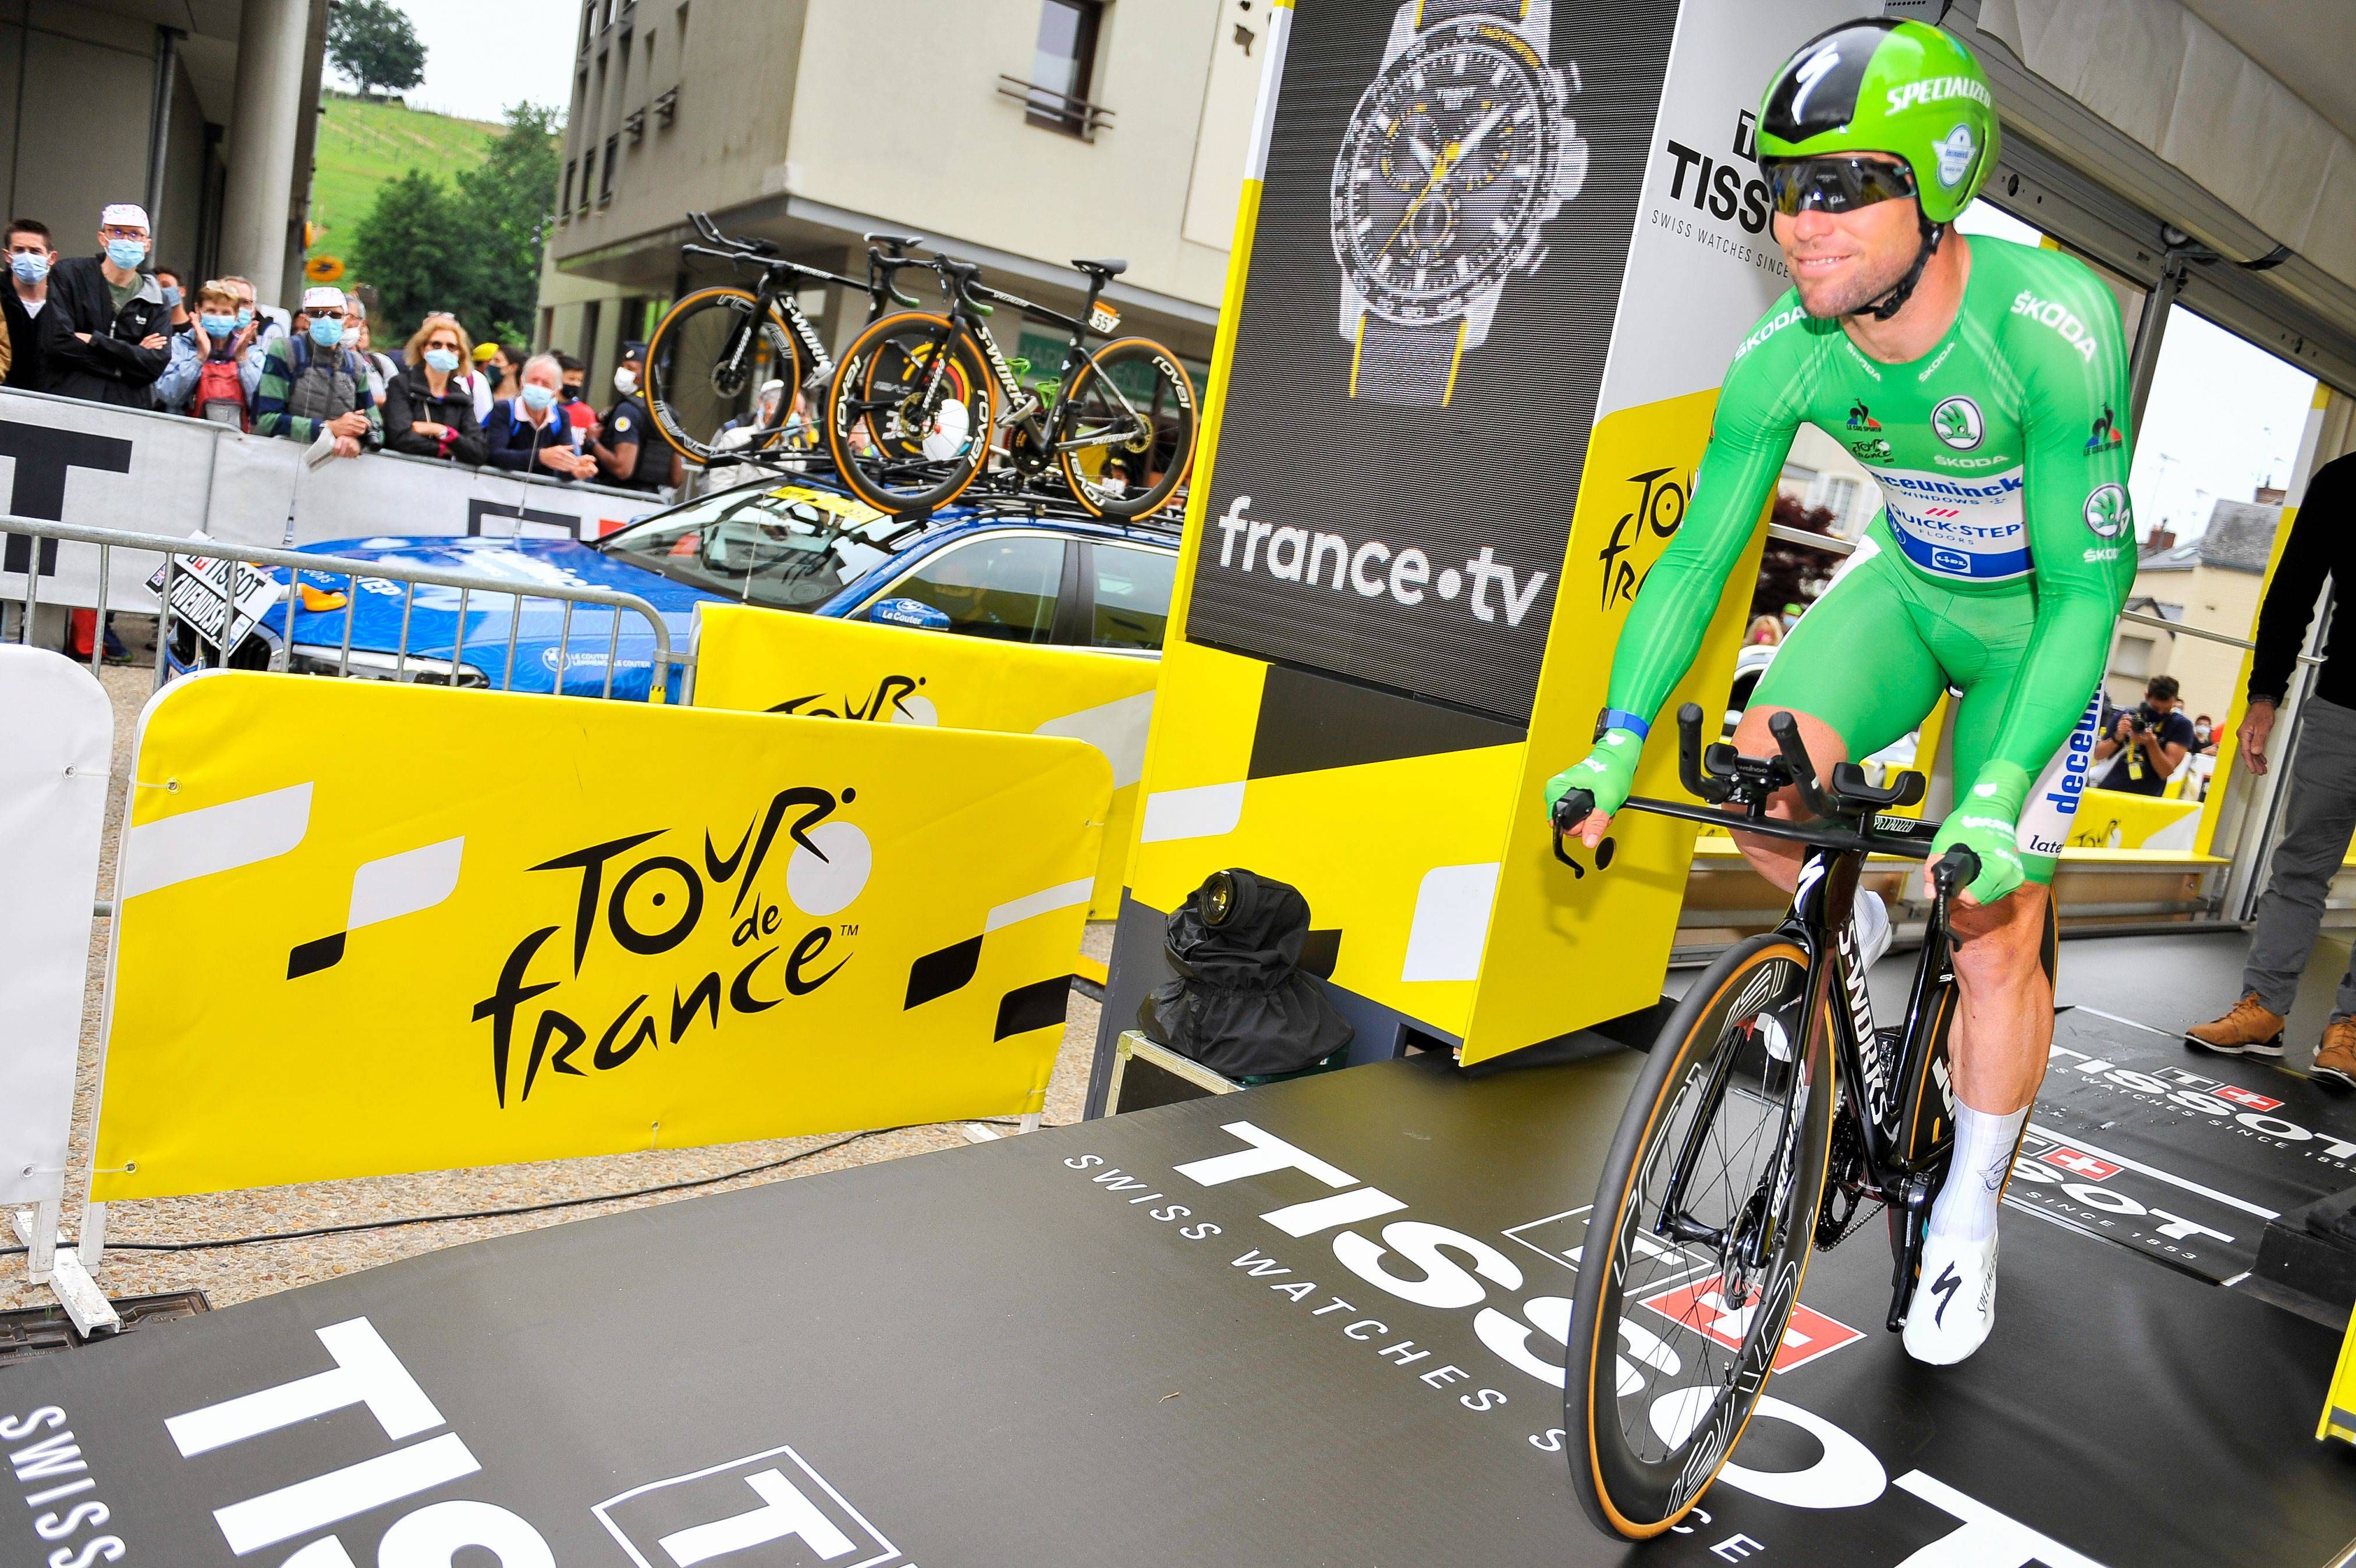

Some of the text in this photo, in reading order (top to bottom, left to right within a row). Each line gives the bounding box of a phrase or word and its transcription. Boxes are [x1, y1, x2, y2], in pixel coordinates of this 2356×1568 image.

[1651, 209, 1789, 278] SWISS WATCHES SINCE
[779, 296, 831, 363] S-WORK
[1095, 314, 1107, 330] 55
[2010, 289, 2098, 363] ŠKODA
[837, 354, 861, 437] roval
[974, 326, 1027, 409] S-WORK
[1151, 356, 1191, 408] roval
[963, 389, 989, 467] roval
[1069, 450, 1106, 506] roval
[1900, 489, 1980, 505] WINDOWS
[1919, 528, 1974, 545] FLOORS
[882, 609, 893, 620] Le
[2029, 835, 2065, 854] late
[524, 787, 836, 981] TOUR
[732, 892, 782, 948] de
[840, 924, 858, 936] TM
[1839, 920, 1887, 1125] S-WORKS
[1770, 1059, 1806, 1219] SPECIALIZED
[2081, 1075, 2196, 1118] WATCHES
[2208, 1119, 2290, 1149] SINCE
[2012, 1157, 2236, 1244] SOT
[2026, 1191, 2197, 1260] SINCE 1853
[1063, 1153, 1223, 1240] SWISS
[1230, 1247, 1507, 1412] WATCHES
